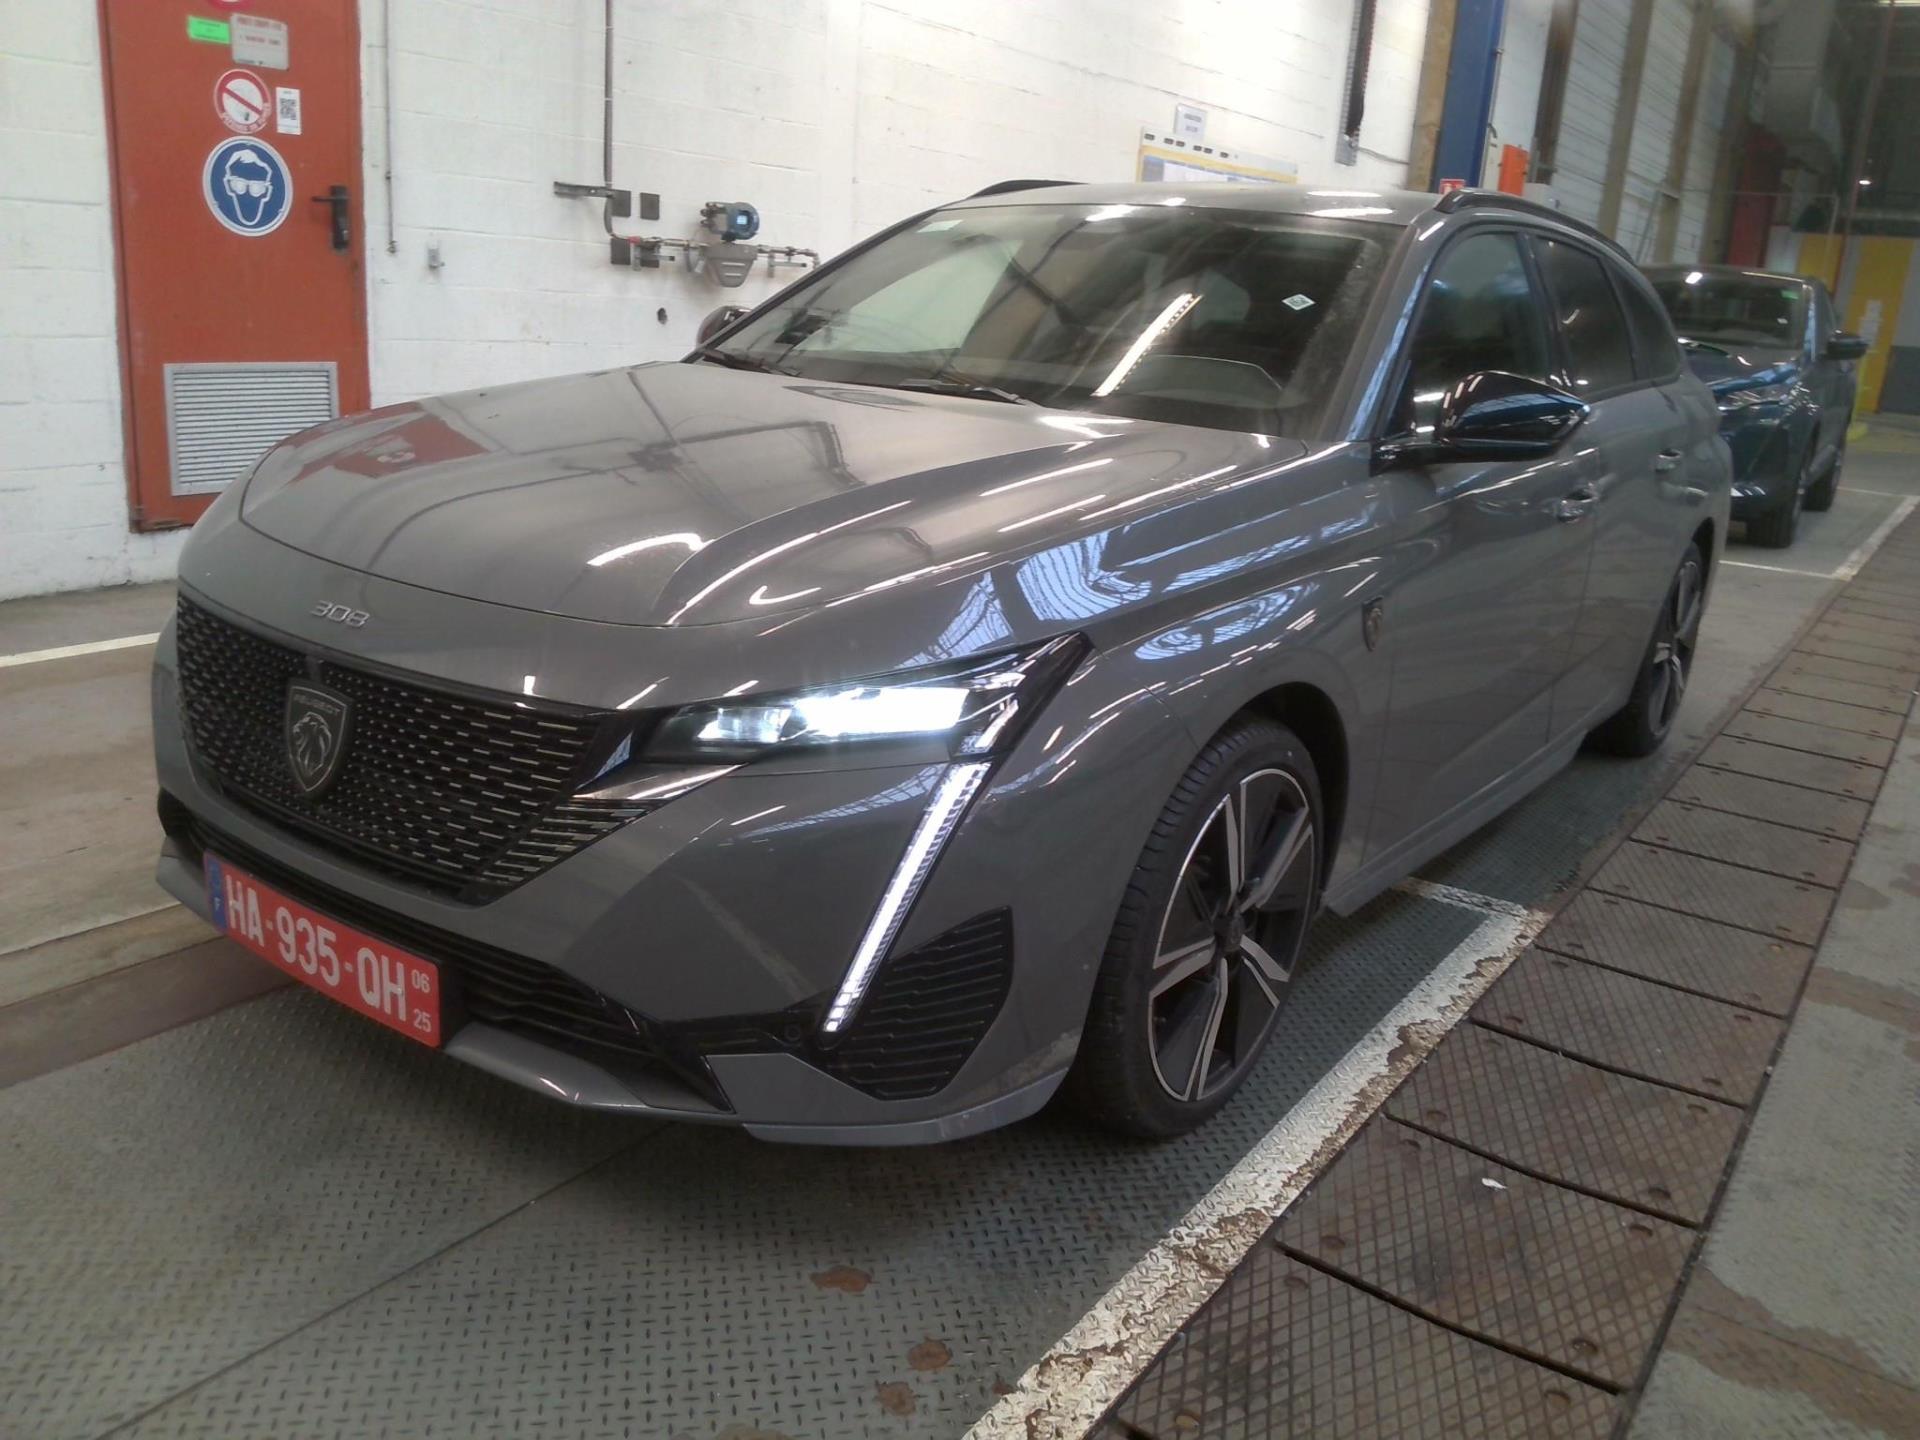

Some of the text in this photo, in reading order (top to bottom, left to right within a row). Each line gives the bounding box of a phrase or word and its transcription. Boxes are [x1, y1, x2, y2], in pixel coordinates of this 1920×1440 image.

[309, 600, 370, 627] 308
[226, 874, 406, 1022] HA-935-QH
[411, 969, 430, 993] 06
[413, 1008, 431, 1033] 25
